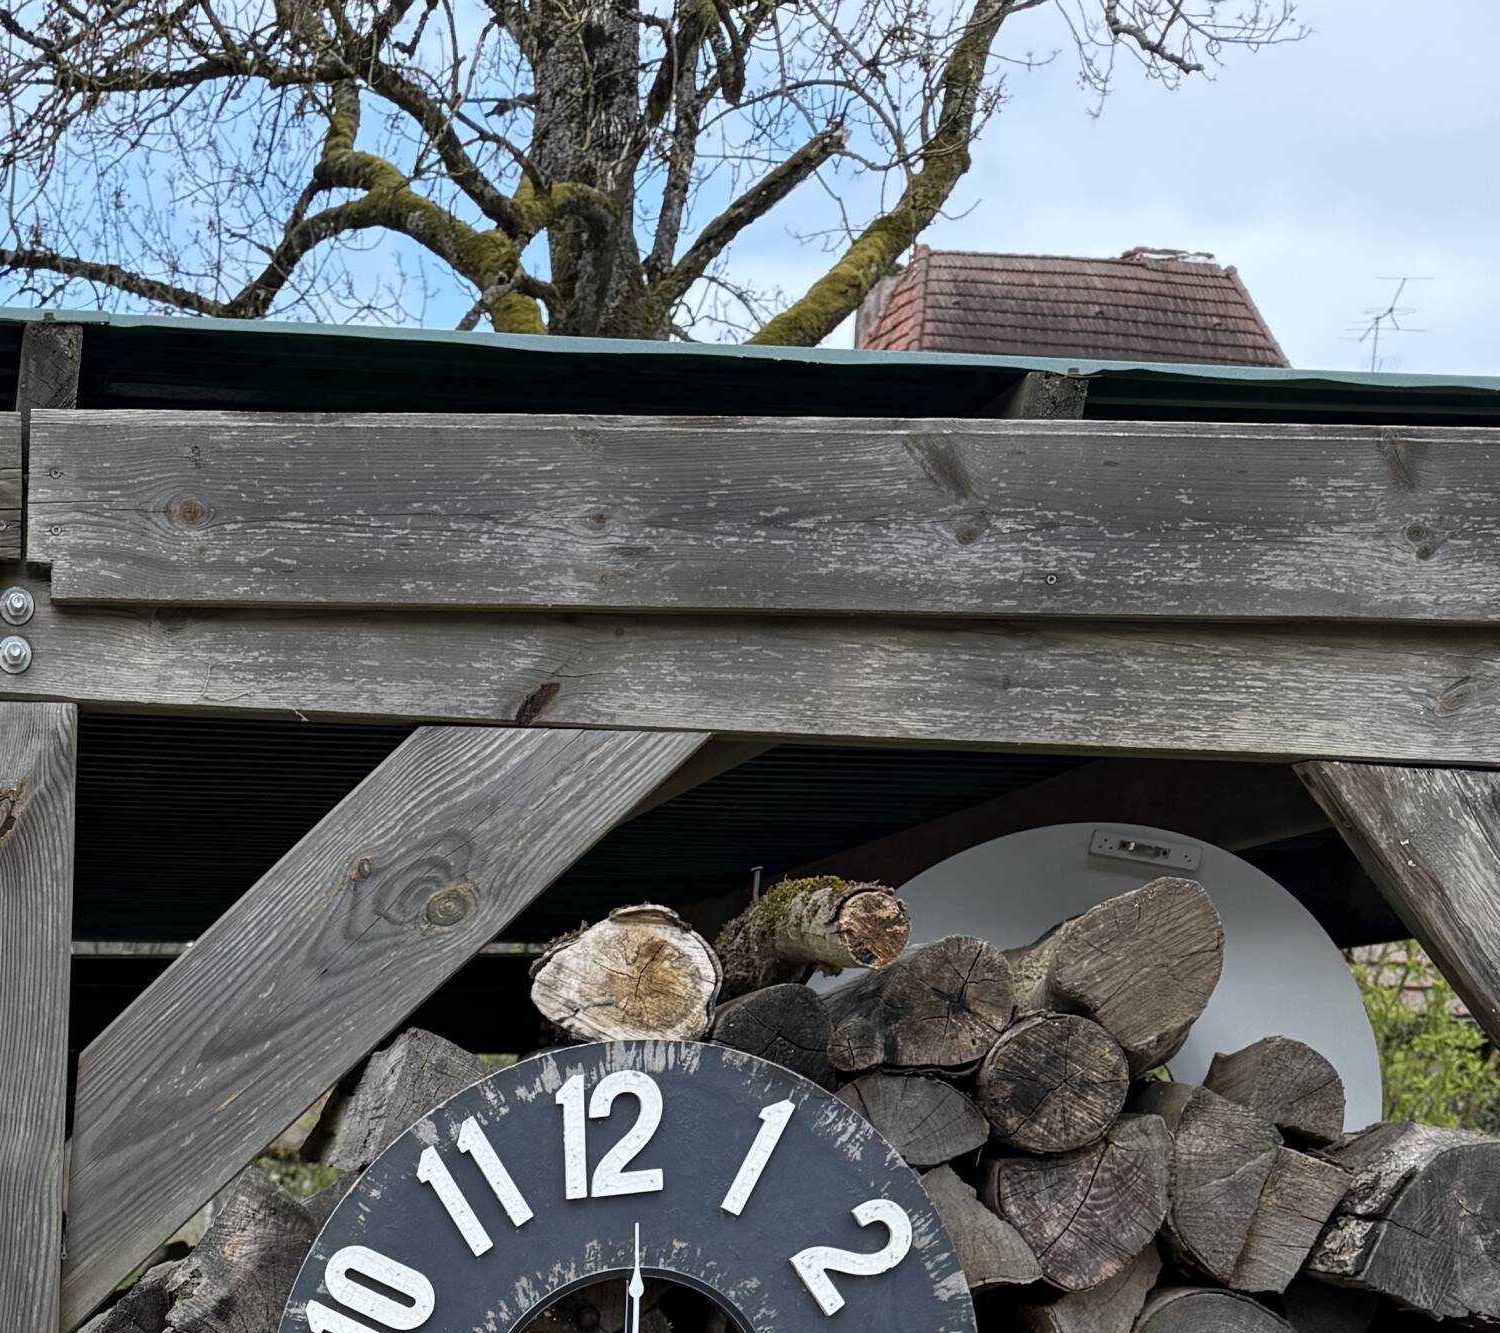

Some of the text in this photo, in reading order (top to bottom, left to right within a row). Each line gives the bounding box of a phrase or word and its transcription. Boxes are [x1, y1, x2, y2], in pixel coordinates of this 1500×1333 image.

[417, 1116, 533, 1256] 11
[556, 1070, 663, 1199] 12
[721, 1100, 795, 1215] 1
[790, 1199, 912, 1315] 2
